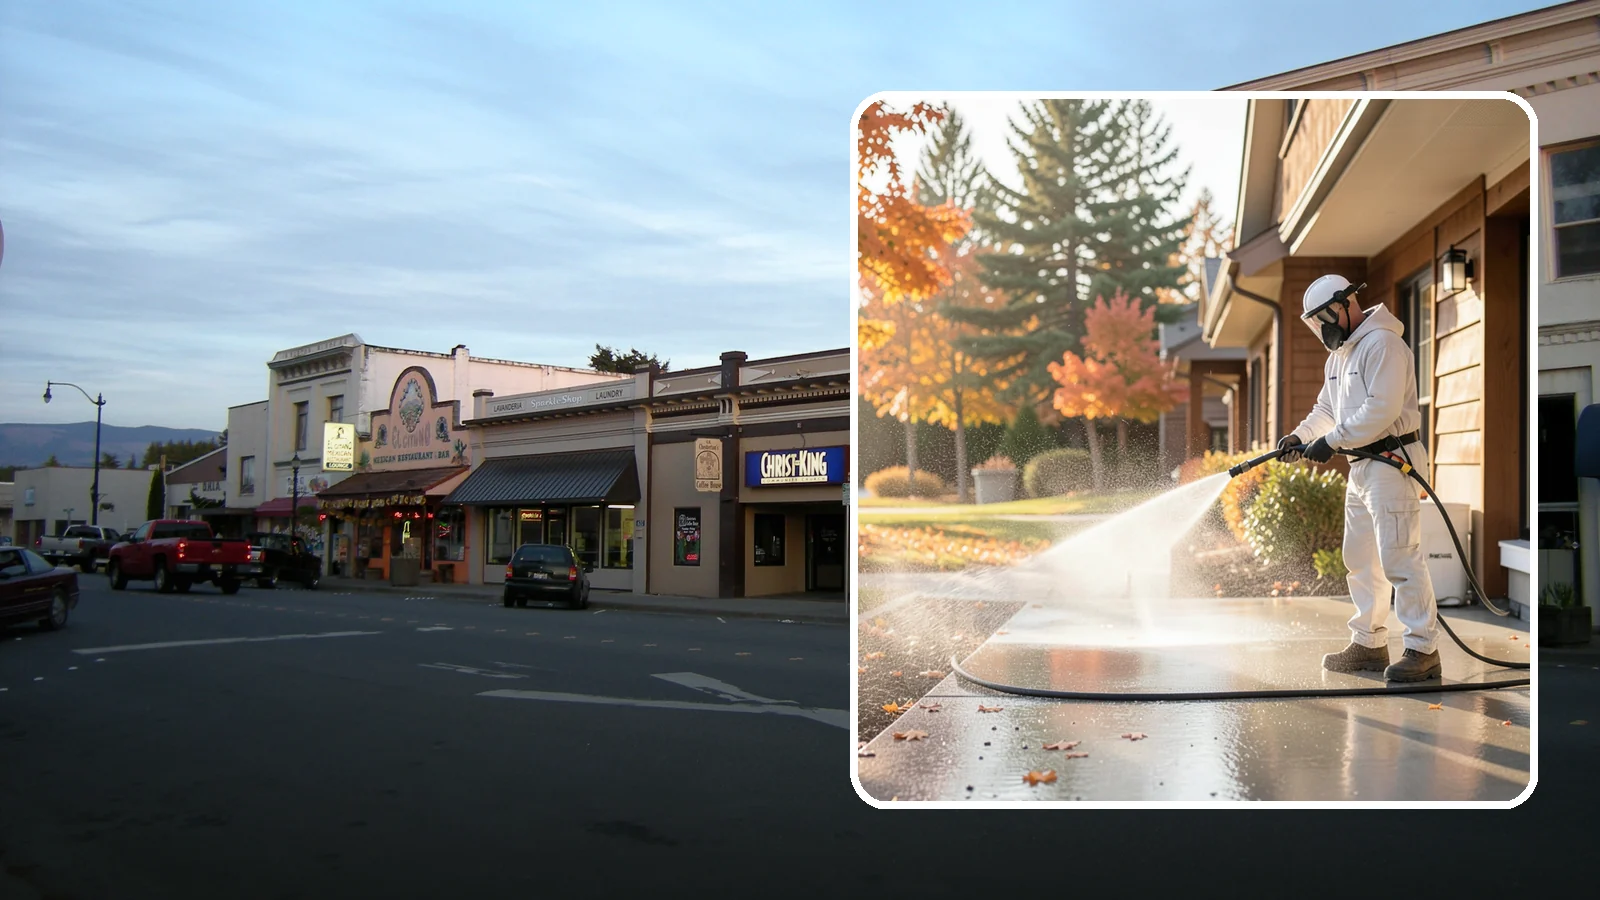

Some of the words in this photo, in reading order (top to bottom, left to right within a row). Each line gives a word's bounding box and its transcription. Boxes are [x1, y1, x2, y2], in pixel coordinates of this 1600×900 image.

[494, 402, 522, 412] LAVANDERIA
[562, 395, 582, 405] Shop
[596, 389, 624, 400] LAUNDRY
[373, 455, 396, 464] MEXICAN
[397, 451, 433, 462] RESTAURANT
[438, 450, 450, 459] BAR
[761, 452, 797, 478] CHRIST
[799, 450, 827, 476] KING
